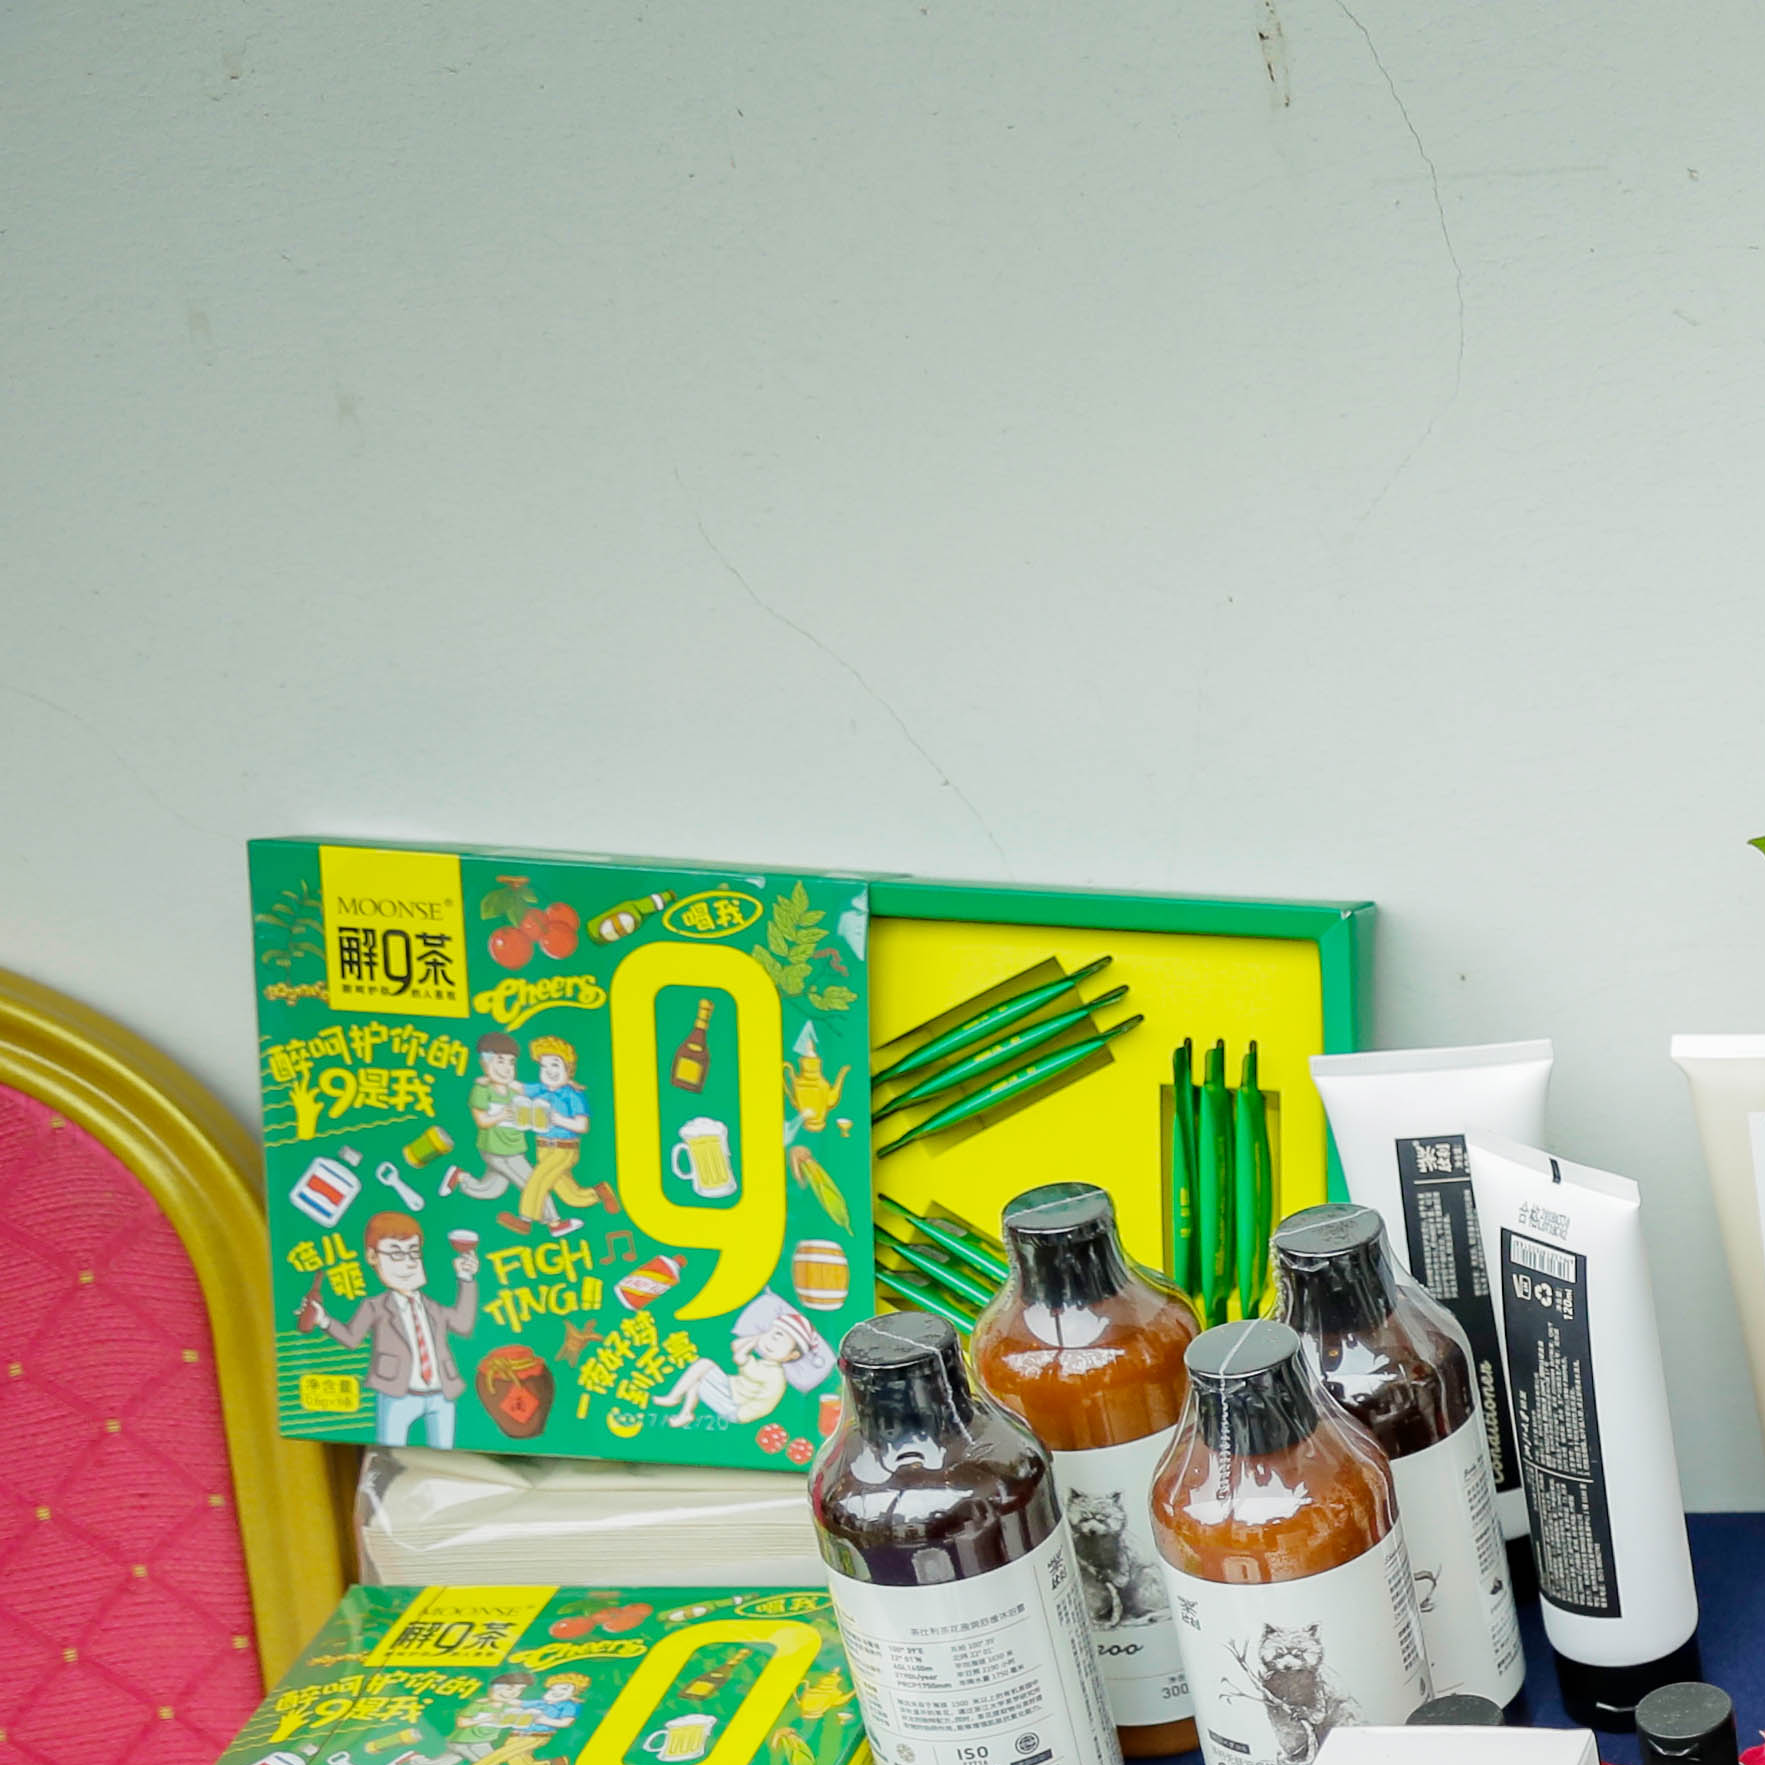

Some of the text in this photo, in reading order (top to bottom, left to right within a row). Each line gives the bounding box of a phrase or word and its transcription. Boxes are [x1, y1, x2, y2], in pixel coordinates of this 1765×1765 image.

[474, 975, 606, 1031] Cheers
[487, 1238, 593, 1283] FIGH
[1162, 1683, 1189, 1699] 300
[957, 1746, 989, 1760] ISO
